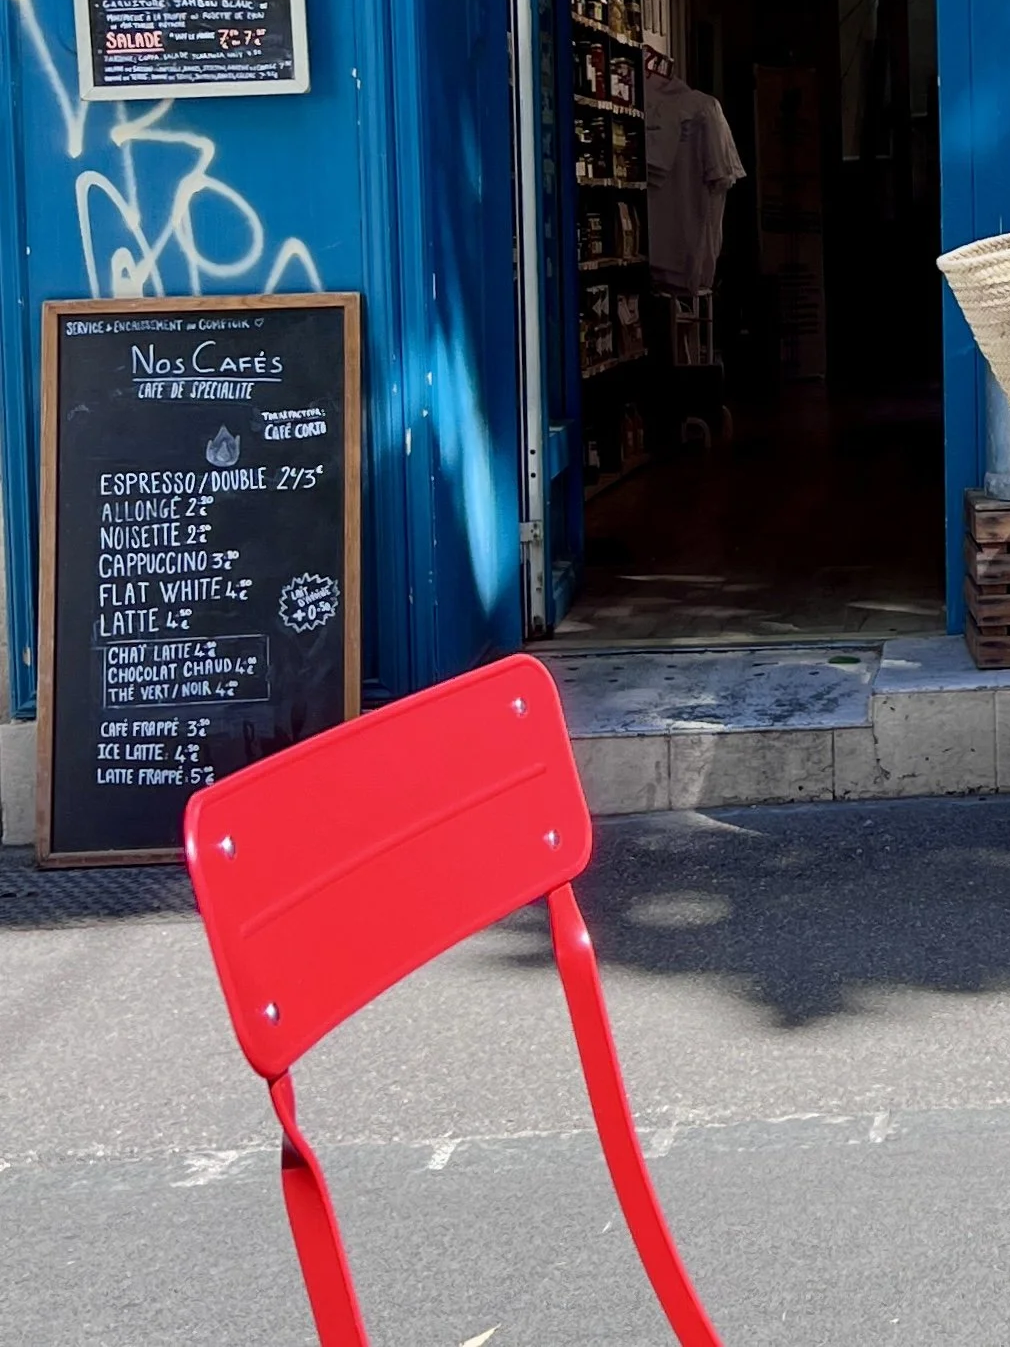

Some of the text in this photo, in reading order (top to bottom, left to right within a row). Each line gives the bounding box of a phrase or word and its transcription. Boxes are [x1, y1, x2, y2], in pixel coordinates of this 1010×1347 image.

[222, 0, 255, 10] BLANC
[106, 31, 164, 49] SALADE
[65, 320, 104, 336] SERVICE
[113, 319, 183, 333] ENCAISSEMENT
[198, 317, 250, 333] COMPTOIR
[191, 340, 284, 374] CAFÉS
[170, 381, 183, 399] DE
[264, 420, 327, 440] CAFÉ CORTO
[101, 496, 181, 523] ALLONGÉ
[100, 522, 181, 550] NOISETTE
[99, 550, 208, 579] CAPPUCCINO
[99, 581, 150, 607] FLAT
[159, 576, 224, 604] WHITE
[99, 607, 160, 638] LATTE
[153, 642, 190, 663] LATTE
[108, 663, 178, 685] CHOCOLAT
[183, 658, 233, 679] CHAUD
[108, 682, 134, 702] THÉ
[100, 718, 128, 738] CAFÉ
[132, 717, 179, 738] FRAPPÉ
[97, 743, 121, 762] ICE
[97, 768, 134, 786] LATTE
